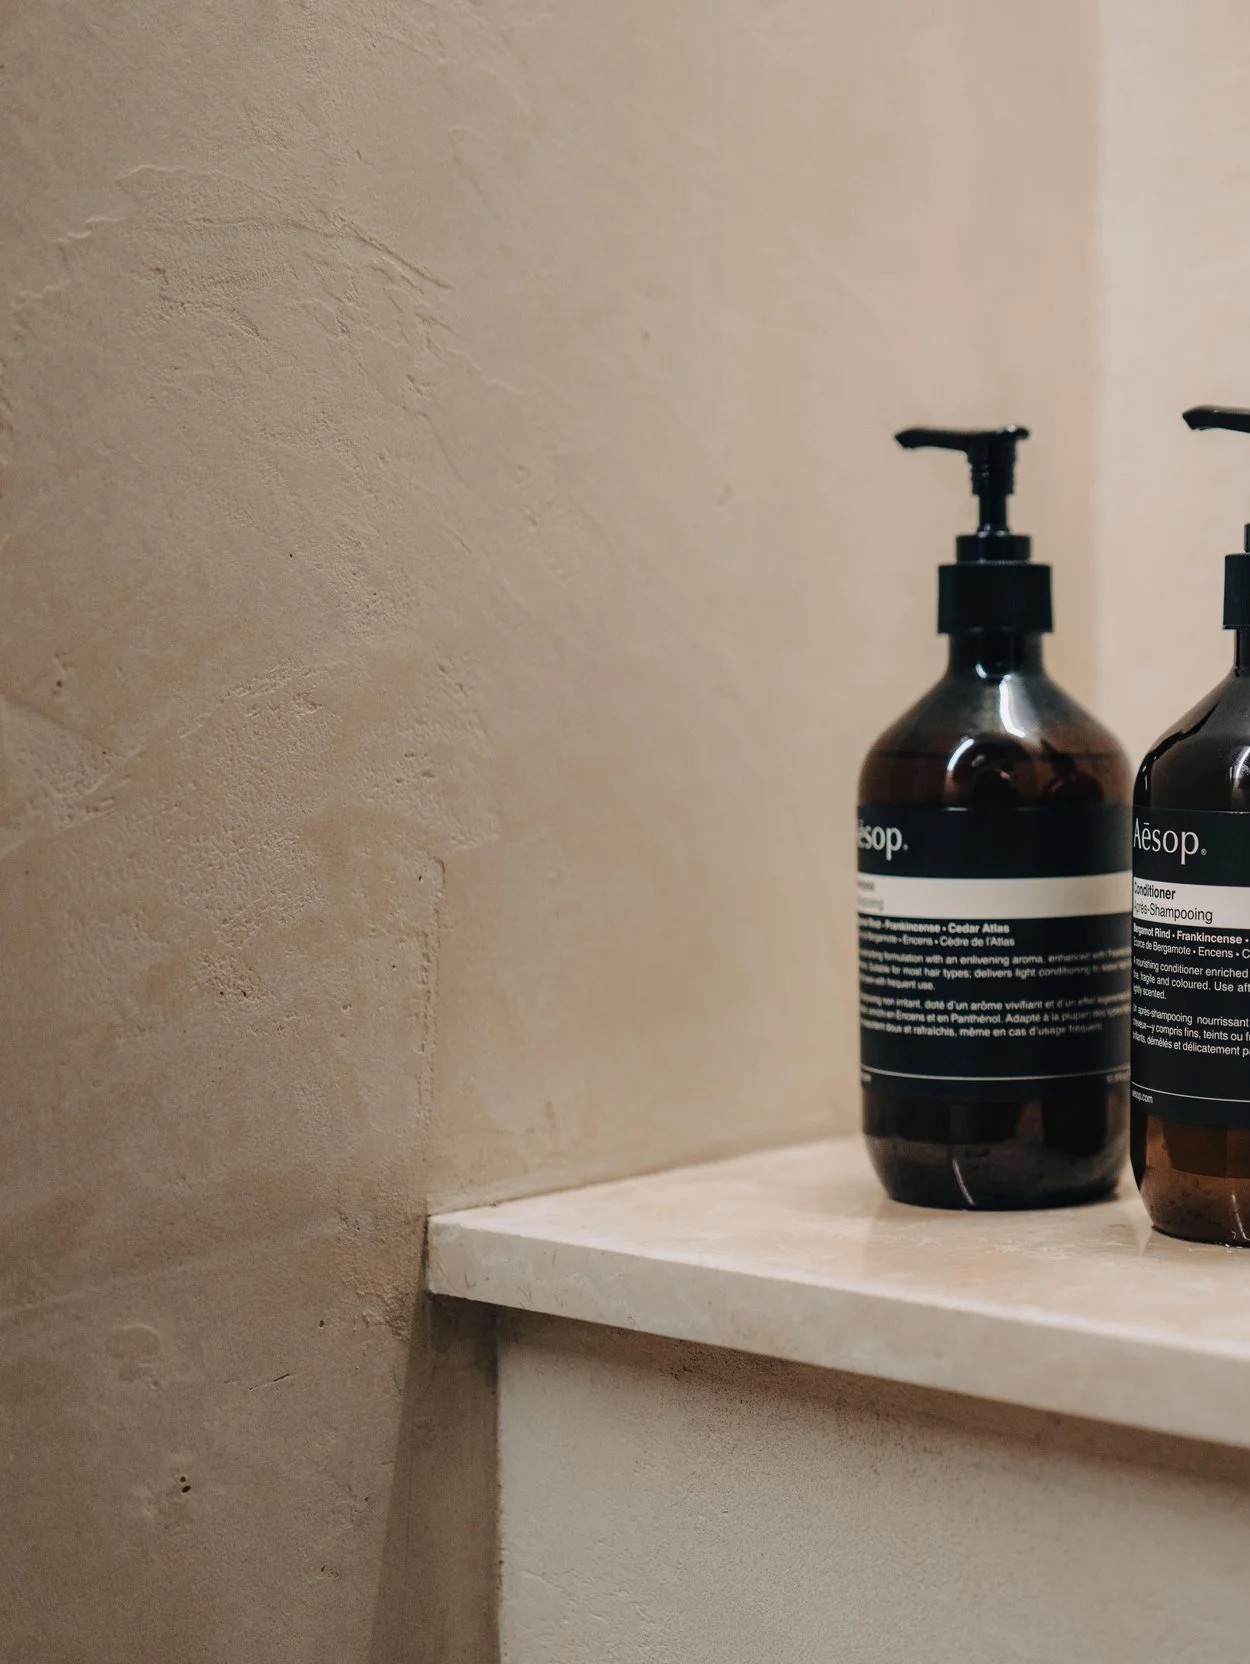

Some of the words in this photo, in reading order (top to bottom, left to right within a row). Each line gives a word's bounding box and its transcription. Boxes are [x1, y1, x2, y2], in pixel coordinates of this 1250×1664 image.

[947, 922, 980, 934] Cedar
[982, 922, 1010, 934] Atlas
[902, 934, 933, 945] Encens
[970, 938, 984, 947] de
[1154, 927, 1171, 939] Rind
[1176, 930, 1242, 945] Frankincense
[1145, 940, 1153, 951] de
[1153, 941, 1191, 955] Bergamote
[1198, 946, 1234, 958] Encens
[925, 954, 944, 964] with
[945, 956, 958, 965] an
[960, 954, 1010, 968] enlivening
[924, 967, 941, 978] hair
[974, 968, 1012, 979] delivers
[1015, 967, 1036, 980] light
[1160, 963, 1203, 976] conditioner
[1205, 967, 1249, 979] enriched
[918, 981, 936, 991] use.
[1156, 977, 1170, 987] and
[1171, 979, 1212, 991] coloured.
[1214, 981, 1234, 992] Use
[1142, 987, 1167, 1000] scented.
[924, 1000, 946, 1010] doté
[947, 999, 968, 1010] d'un
[970, 1000, 1003, 1011] arôme
[926, 1012, 936, 1022] et
[937, 1014, 949, 1024] en
[1005, 1013, 1041, 1025] Adapté
[1196, 1016, 1249, 1028] nourrissant
[959, 1026, 991, 1037] même
[992, 1027, 1007, 1038] en
[1008, 1027, 1027, 1037] cas
[1156, 1025, 1183, 1037] compris
[1184, 1027, 1201, 1040] fins,
[1203, 1029, 1228, 1042] teints
[1230, 1032, 1243, 1042] ou
[1146, 1035, 1172, 1049] démêlés
[1173, 1040, 1181, 1050] et
[1182, 1041, 1240, 1055] délicatement
